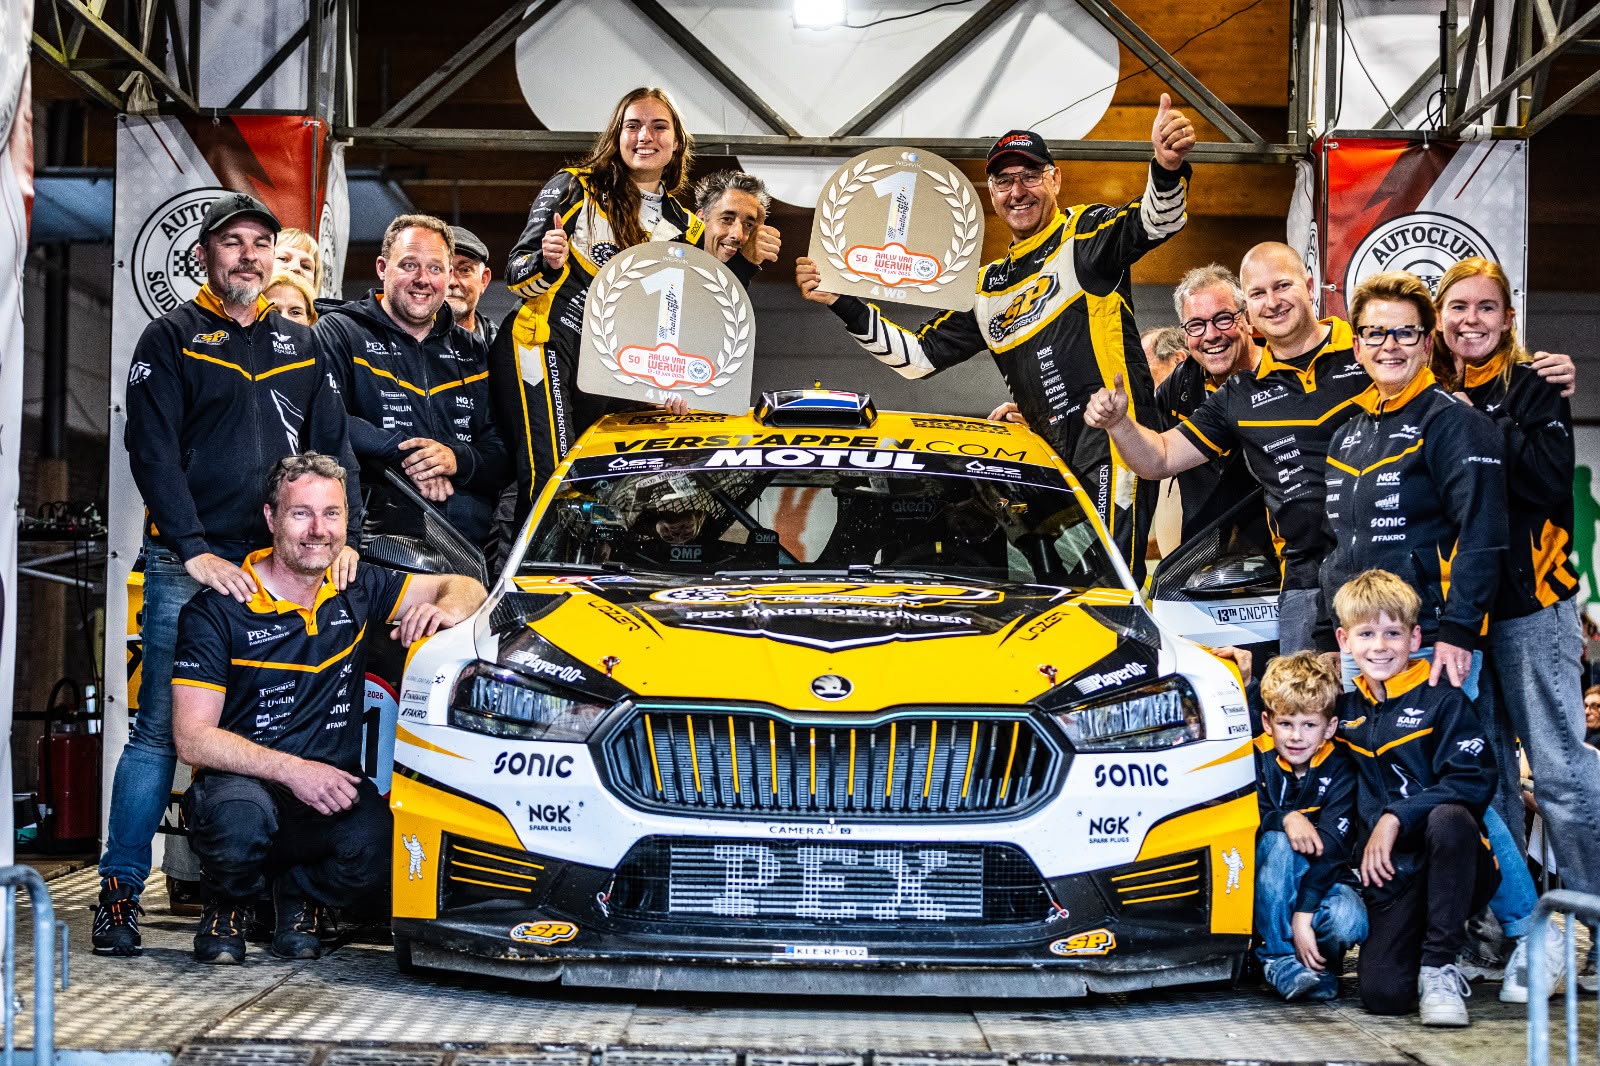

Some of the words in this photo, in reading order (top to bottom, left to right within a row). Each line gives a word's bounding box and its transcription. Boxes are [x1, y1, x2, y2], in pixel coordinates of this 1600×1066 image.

[160, 202, 212, 240] AUTO
[855, 254, 868, 263] 50
[875, 252, 898, 261] RALLY
[898, 255, 913, 264] VAN
[874, 259, 912, 272] WERVIK
[147, 271, 178, 313] SCUD
[272, 340, 295, 351] KART
[547, 349, 558, 369] PEX
[628, 354, 641, 365] 50
[648, 353, 670, 362] RALLY
[671, 356, 686, 365] VAN
[647, 359, 686, 374] WERVIK
[1250, 389, 1272, 404] PEX
[551, 369, 568, 457] DAKBEDEKKINGEN
[704, 449, 926, 470] MOTUL
[1376, 471, 1401, 483] NGK
[1370, 516, 1407, 528] SONIC
[755, 533, 777, 543] OMP
[1377, 533, 1406, 542] FAKRO
[670, 548, 702, 560] OMP
[686, 609, 735, 619] PEX
[741, 607, 972, 625] DAKBEDEKKINGEN
[1239, 605, 1280, 621] CNCPTS
[247, 629, 271, 642] PEX
[367, 690, 384, 700] 2026
[405, 708, 427, 719] FAKRO
[1397, 716, 1423, 725] KART
[493, 751, 575, 779] SONIC
[1095, 763, 1169, 788] SONIC
[528, 804, 572, 824] NGK
[769, 825, 825, 836] CAMERA
[1089, 816, 1130, 836] NGK
[713, 844, 948, 921] PEX
[523, 923, 572, 937] SP
[1065, 935, 1109, 950] SP
